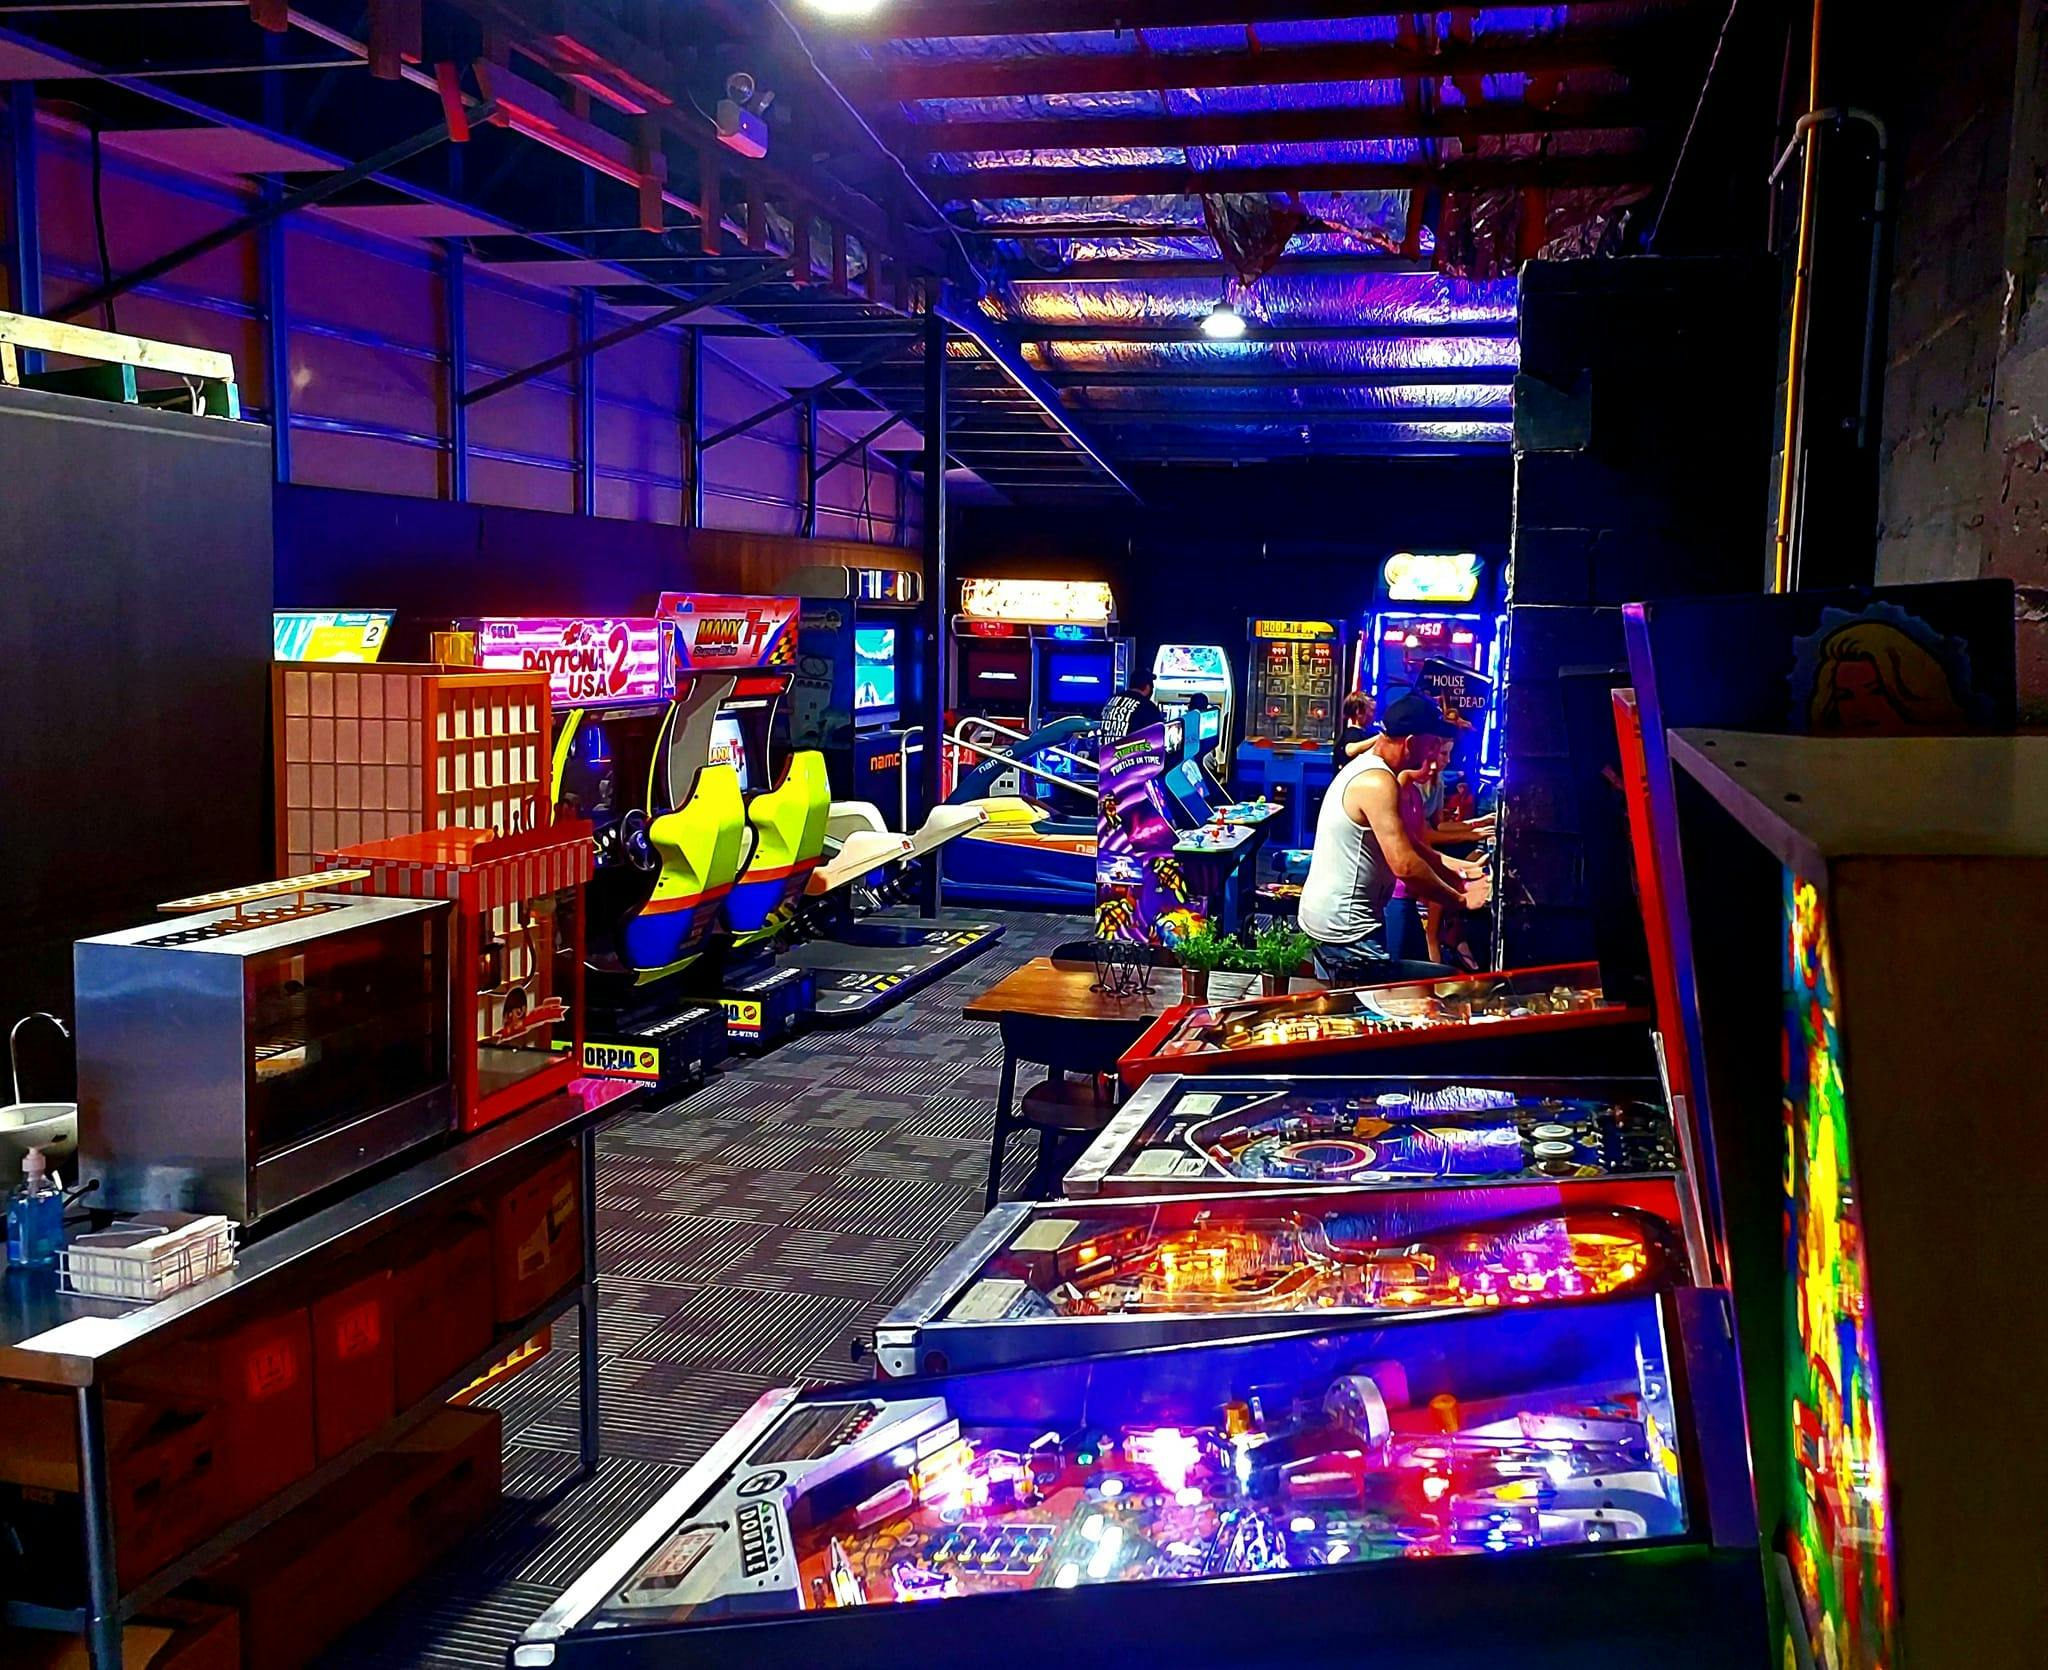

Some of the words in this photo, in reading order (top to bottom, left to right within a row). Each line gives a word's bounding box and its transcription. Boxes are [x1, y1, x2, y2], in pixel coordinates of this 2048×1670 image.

[366, 626, 380, 642] 2
[490, 625, 516, 639] SEGA
[695, 619, 744, 645] MANX
[743, 609, 770, 657] TT
[522, 648, 606, 674] DAYTONA
[607, 624, 630, 695] 2
[568, 673, 608, 699] USA
[1433, 674, 1465, 687] HOUSE
[1459, 696, 1486, 708] DEAD
[870, 752, 901, 771] namc
[978, 749, 1014, 774] namo
